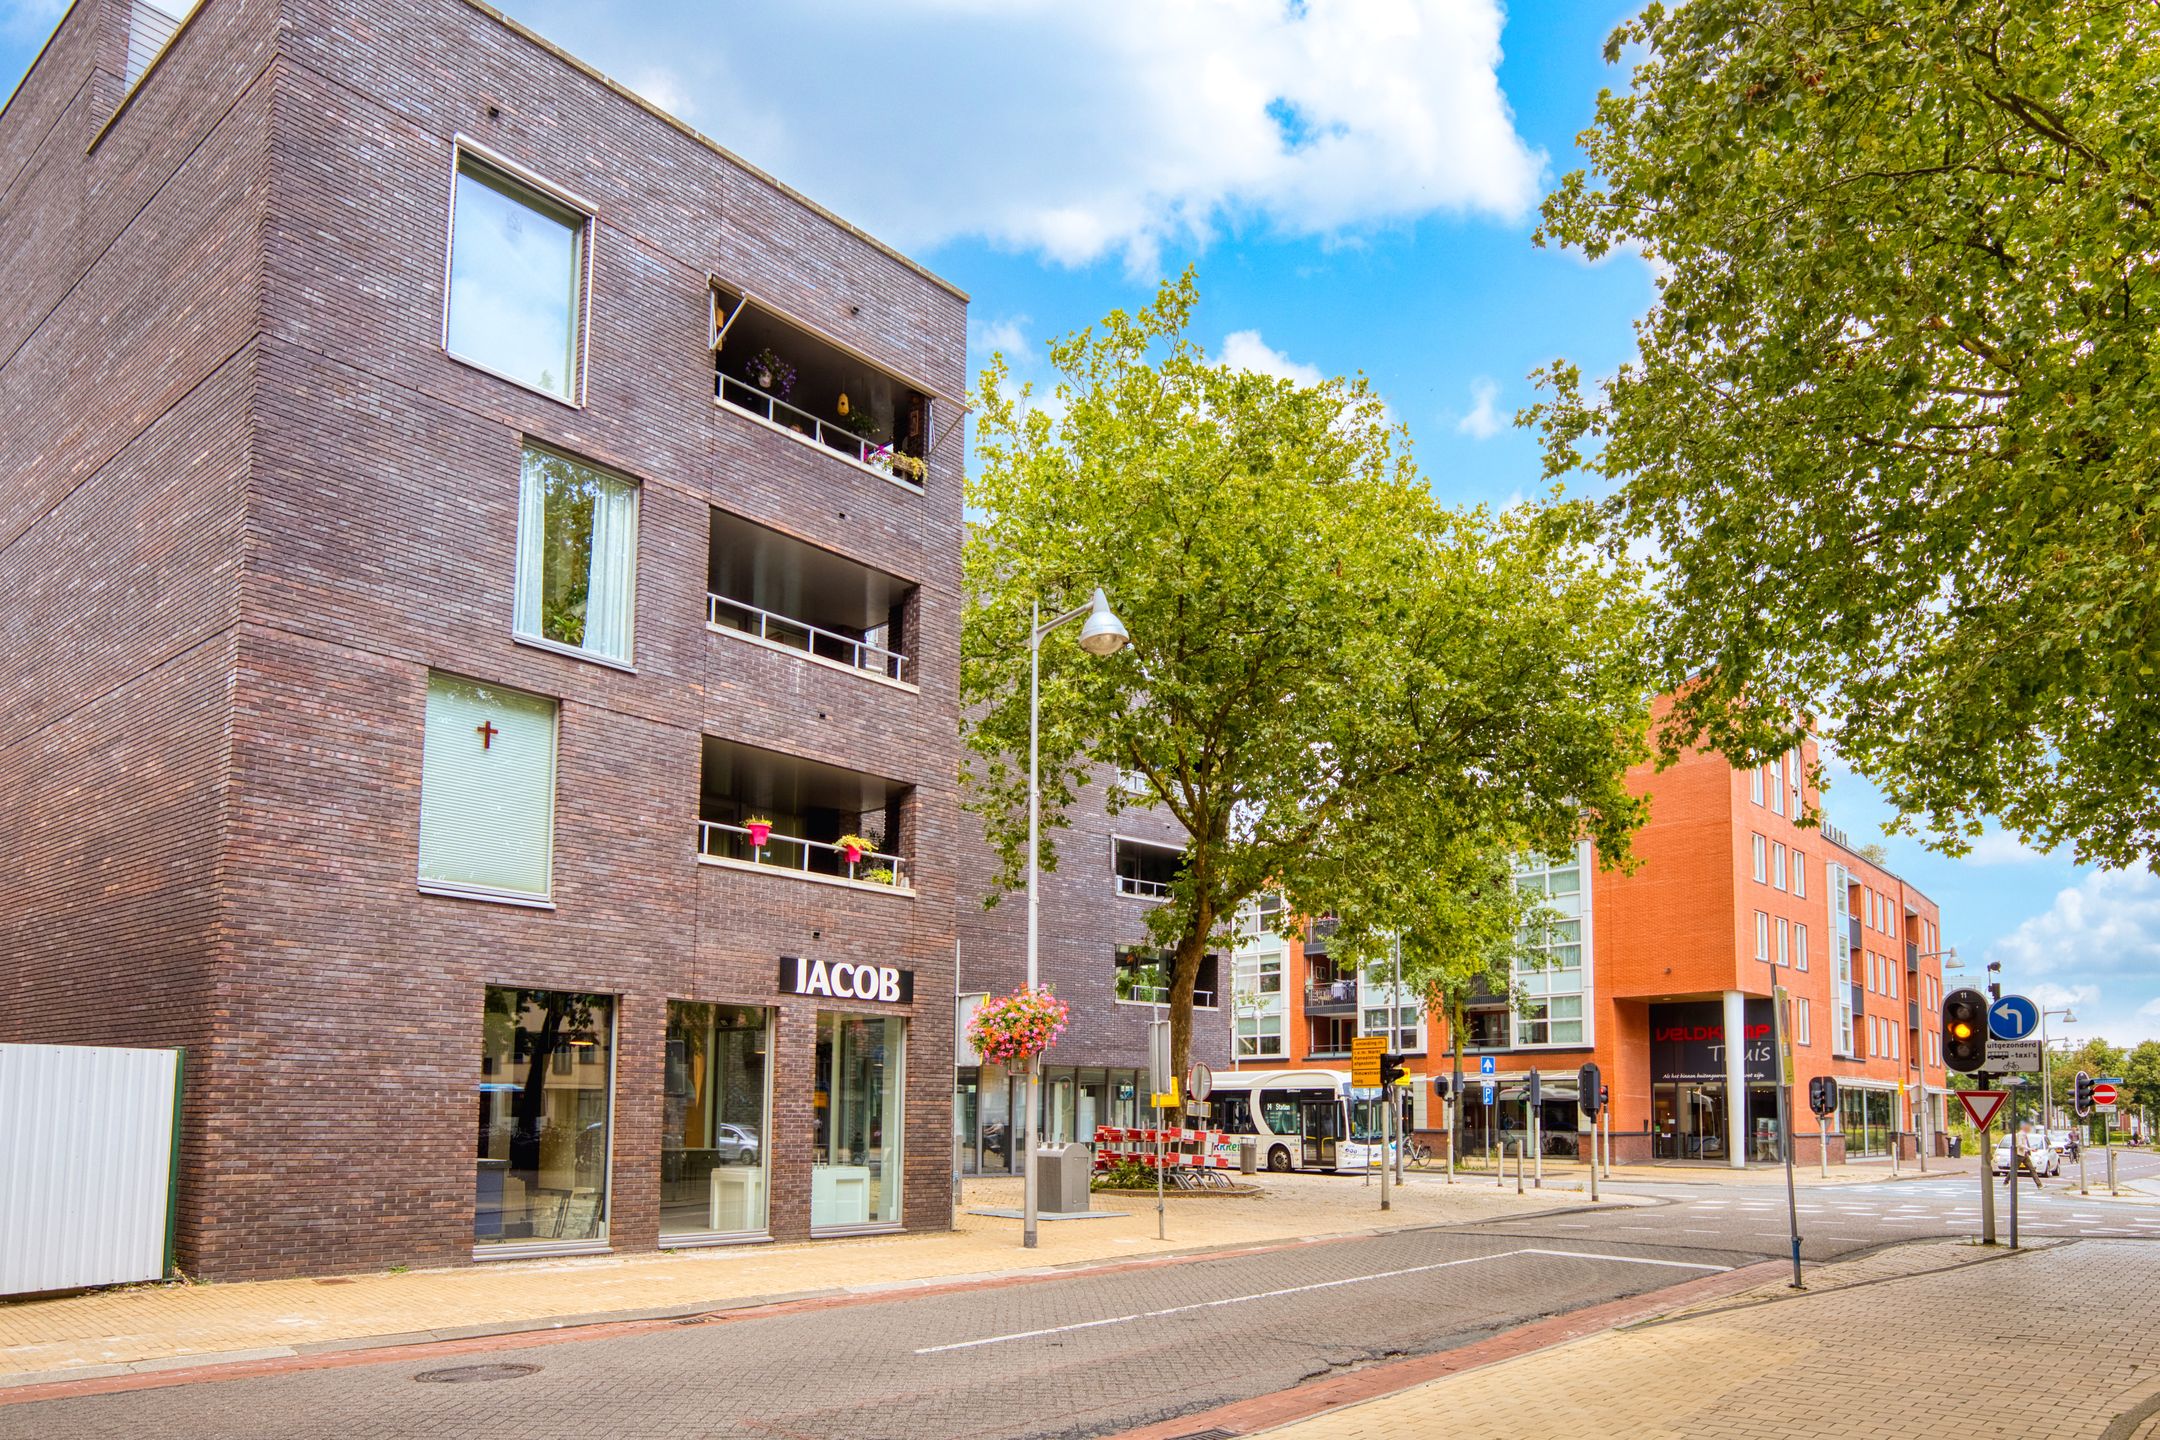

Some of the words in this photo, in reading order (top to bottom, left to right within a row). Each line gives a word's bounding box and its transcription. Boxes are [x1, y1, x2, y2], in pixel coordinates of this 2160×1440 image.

[796, 958, 900, 1001] JACOB
[1707, 1042, 1771, 1062] Tuis
[1987, 1042, 2036, 1050] uitgezonderd
